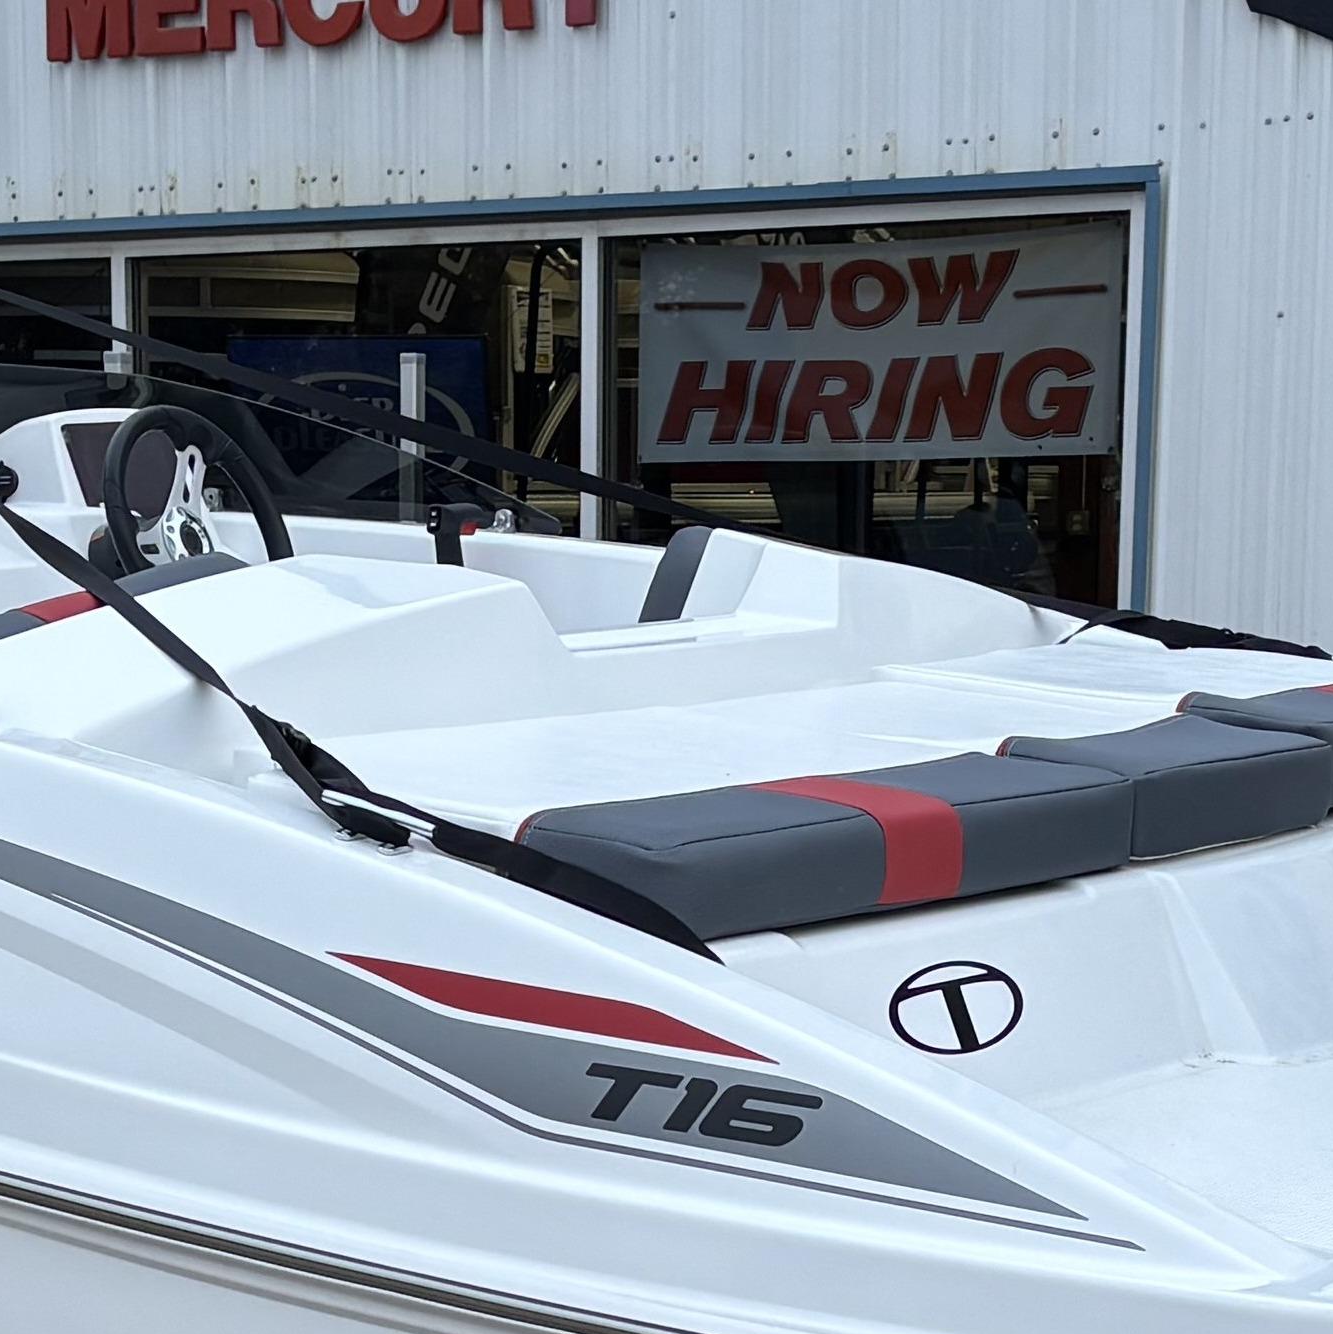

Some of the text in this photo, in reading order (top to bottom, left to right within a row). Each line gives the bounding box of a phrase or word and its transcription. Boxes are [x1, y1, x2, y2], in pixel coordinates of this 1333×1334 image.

[745, 248, 1020, 331] NOW
[656, 346, 1095, 445] HIRING
[585, 1062, 823, 1147] T16
